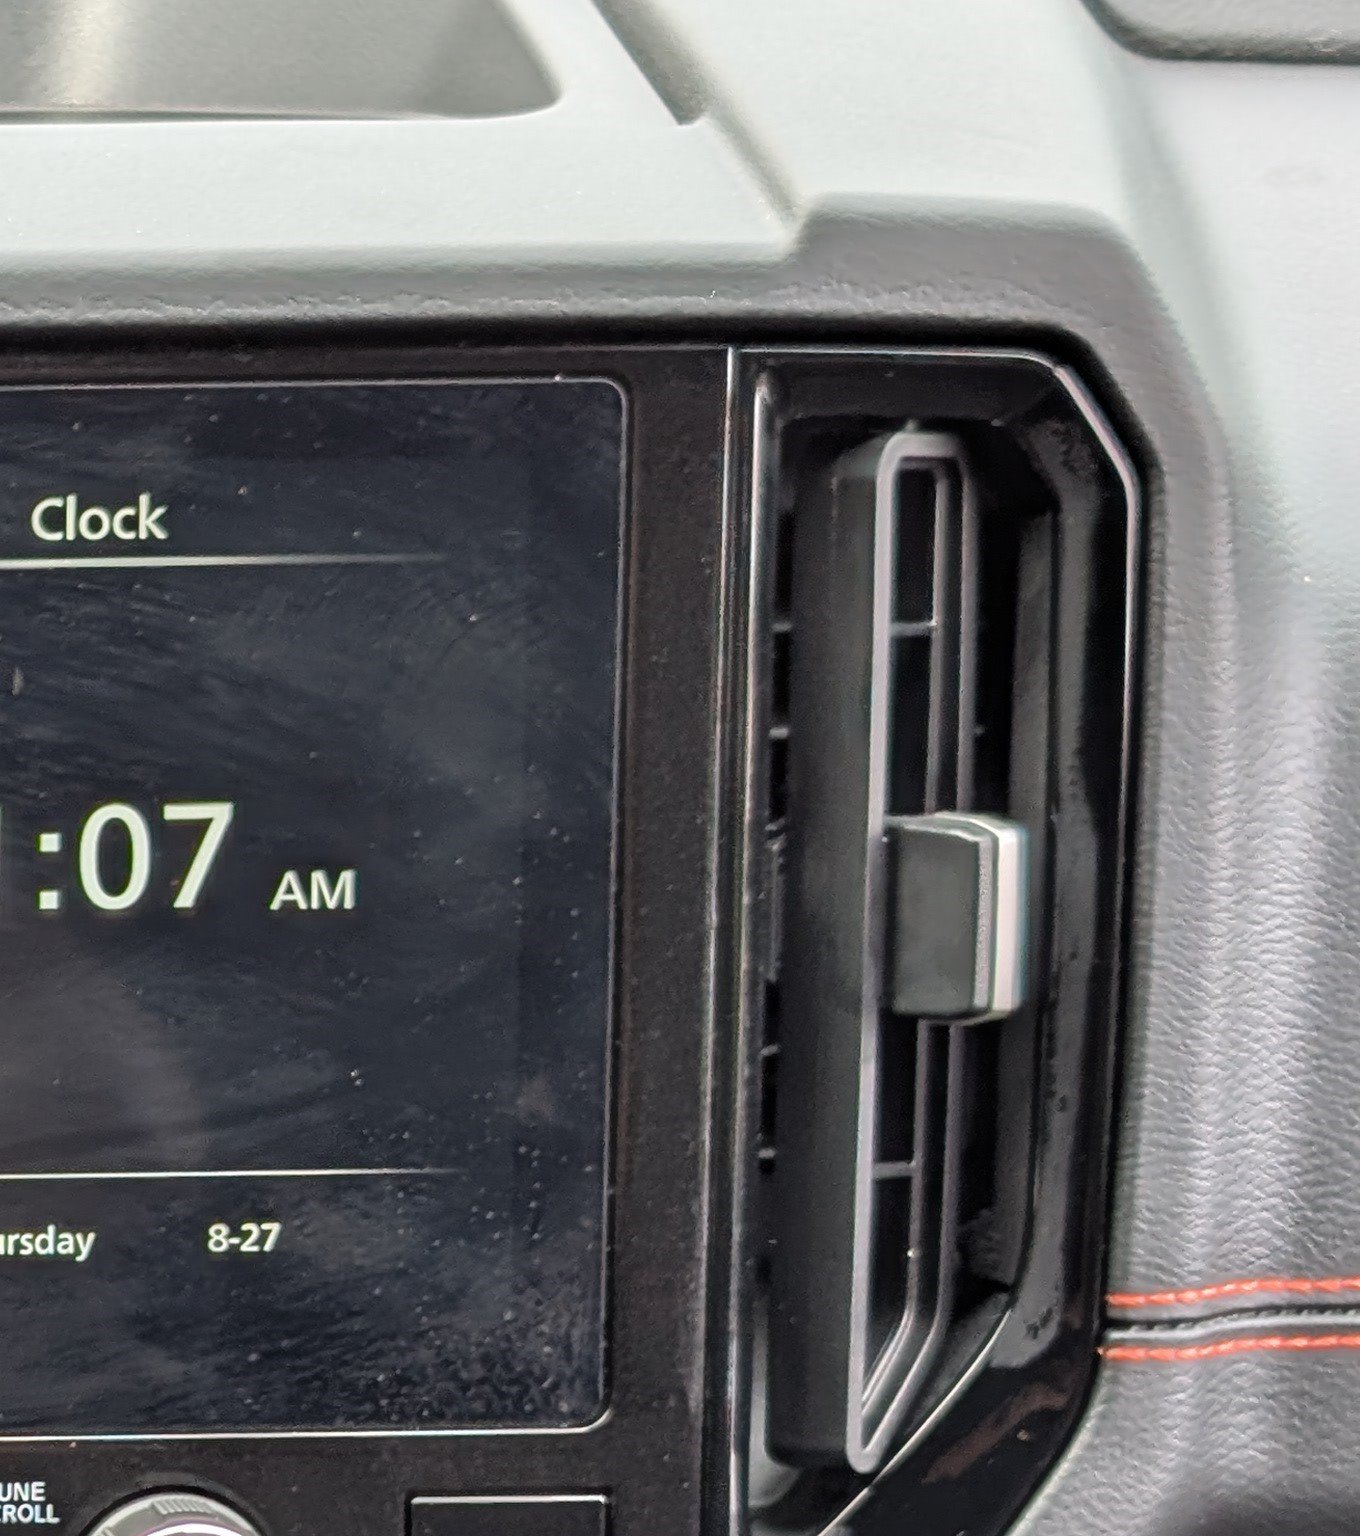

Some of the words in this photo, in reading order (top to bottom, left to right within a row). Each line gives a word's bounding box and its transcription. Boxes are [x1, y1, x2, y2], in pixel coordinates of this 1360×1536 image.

[29, 493, 169, 543] Clock
[268, 869, 357, 911] AM
[206, 1222, 282, 1254] 8-27
